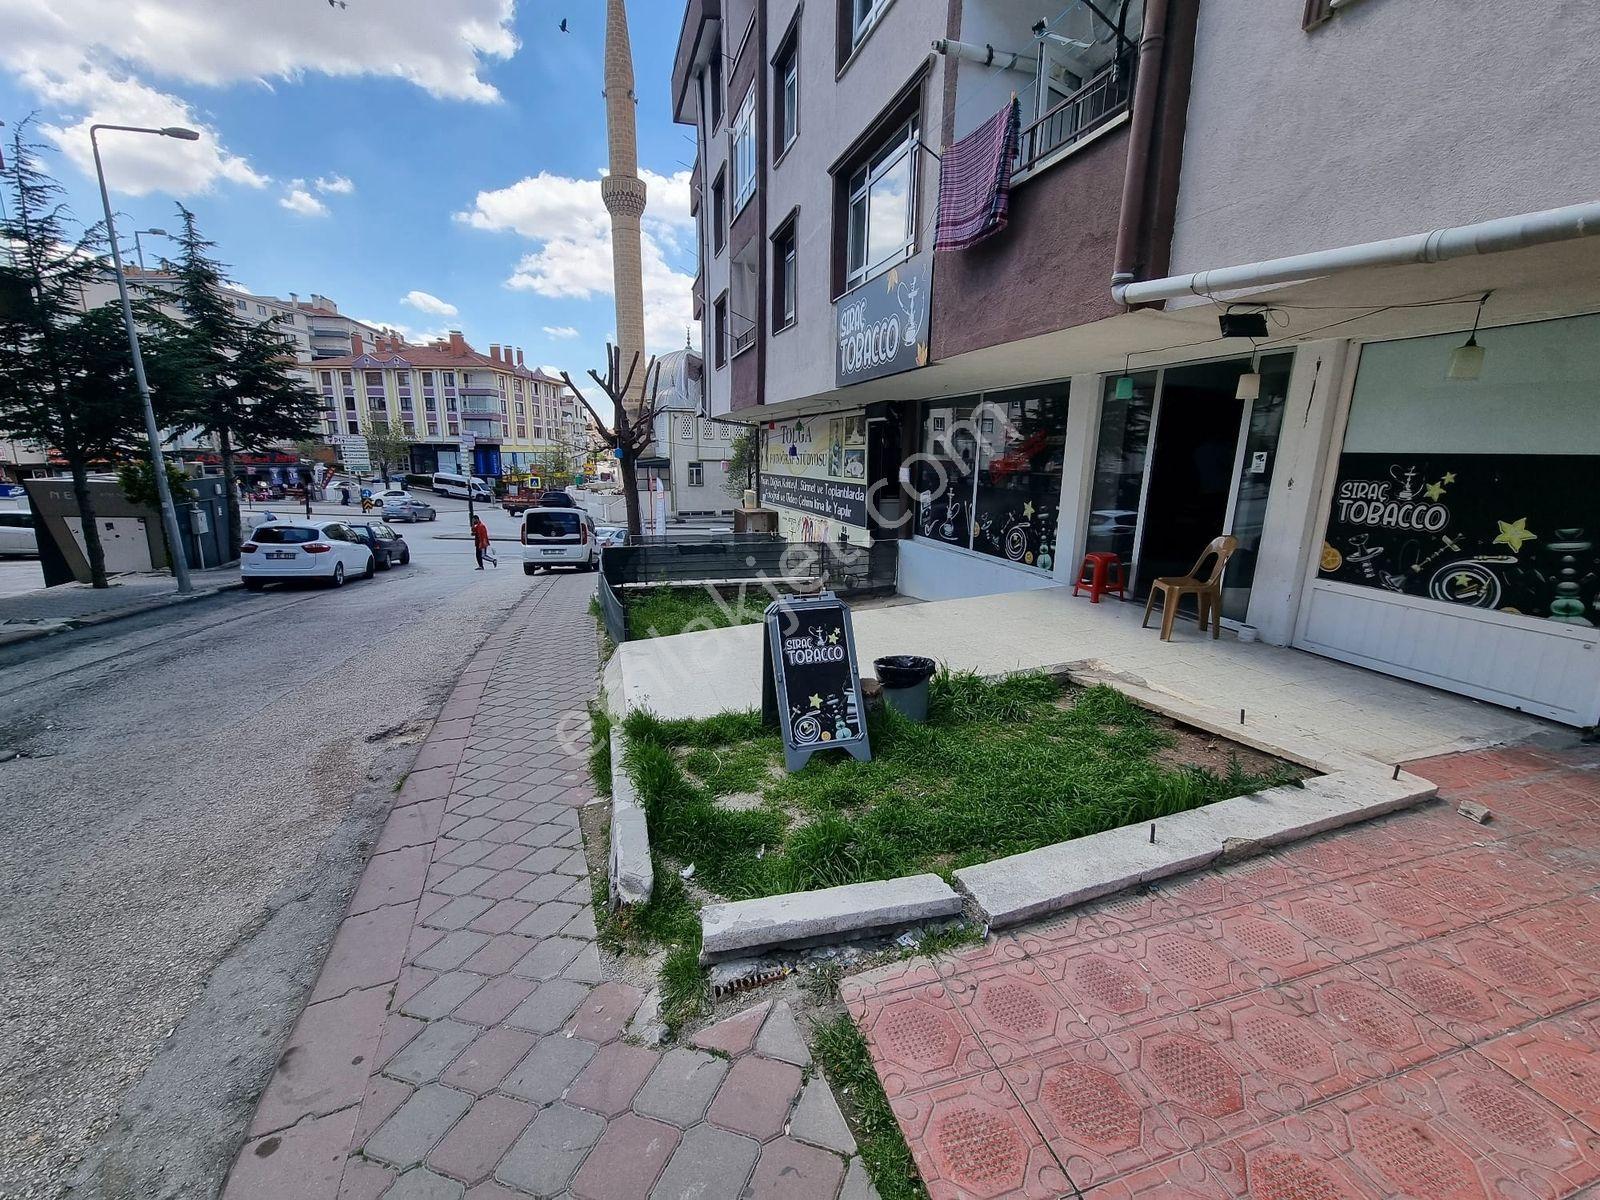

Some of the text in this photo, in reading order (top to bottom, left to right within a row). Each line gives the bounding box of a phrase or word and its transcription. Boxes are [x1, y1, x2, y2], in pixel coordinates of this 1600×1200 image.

[840, 313, 900, 376] TOBACCO
[781, 425, 812, 444] TOLGA
[817, 485, 824, 495] ve
[825, 483, 865, 502] Toplantılarda
[1339, 499, 1448, 531] TOBACCO
[787, 646, 844, 665] TOBACCO
